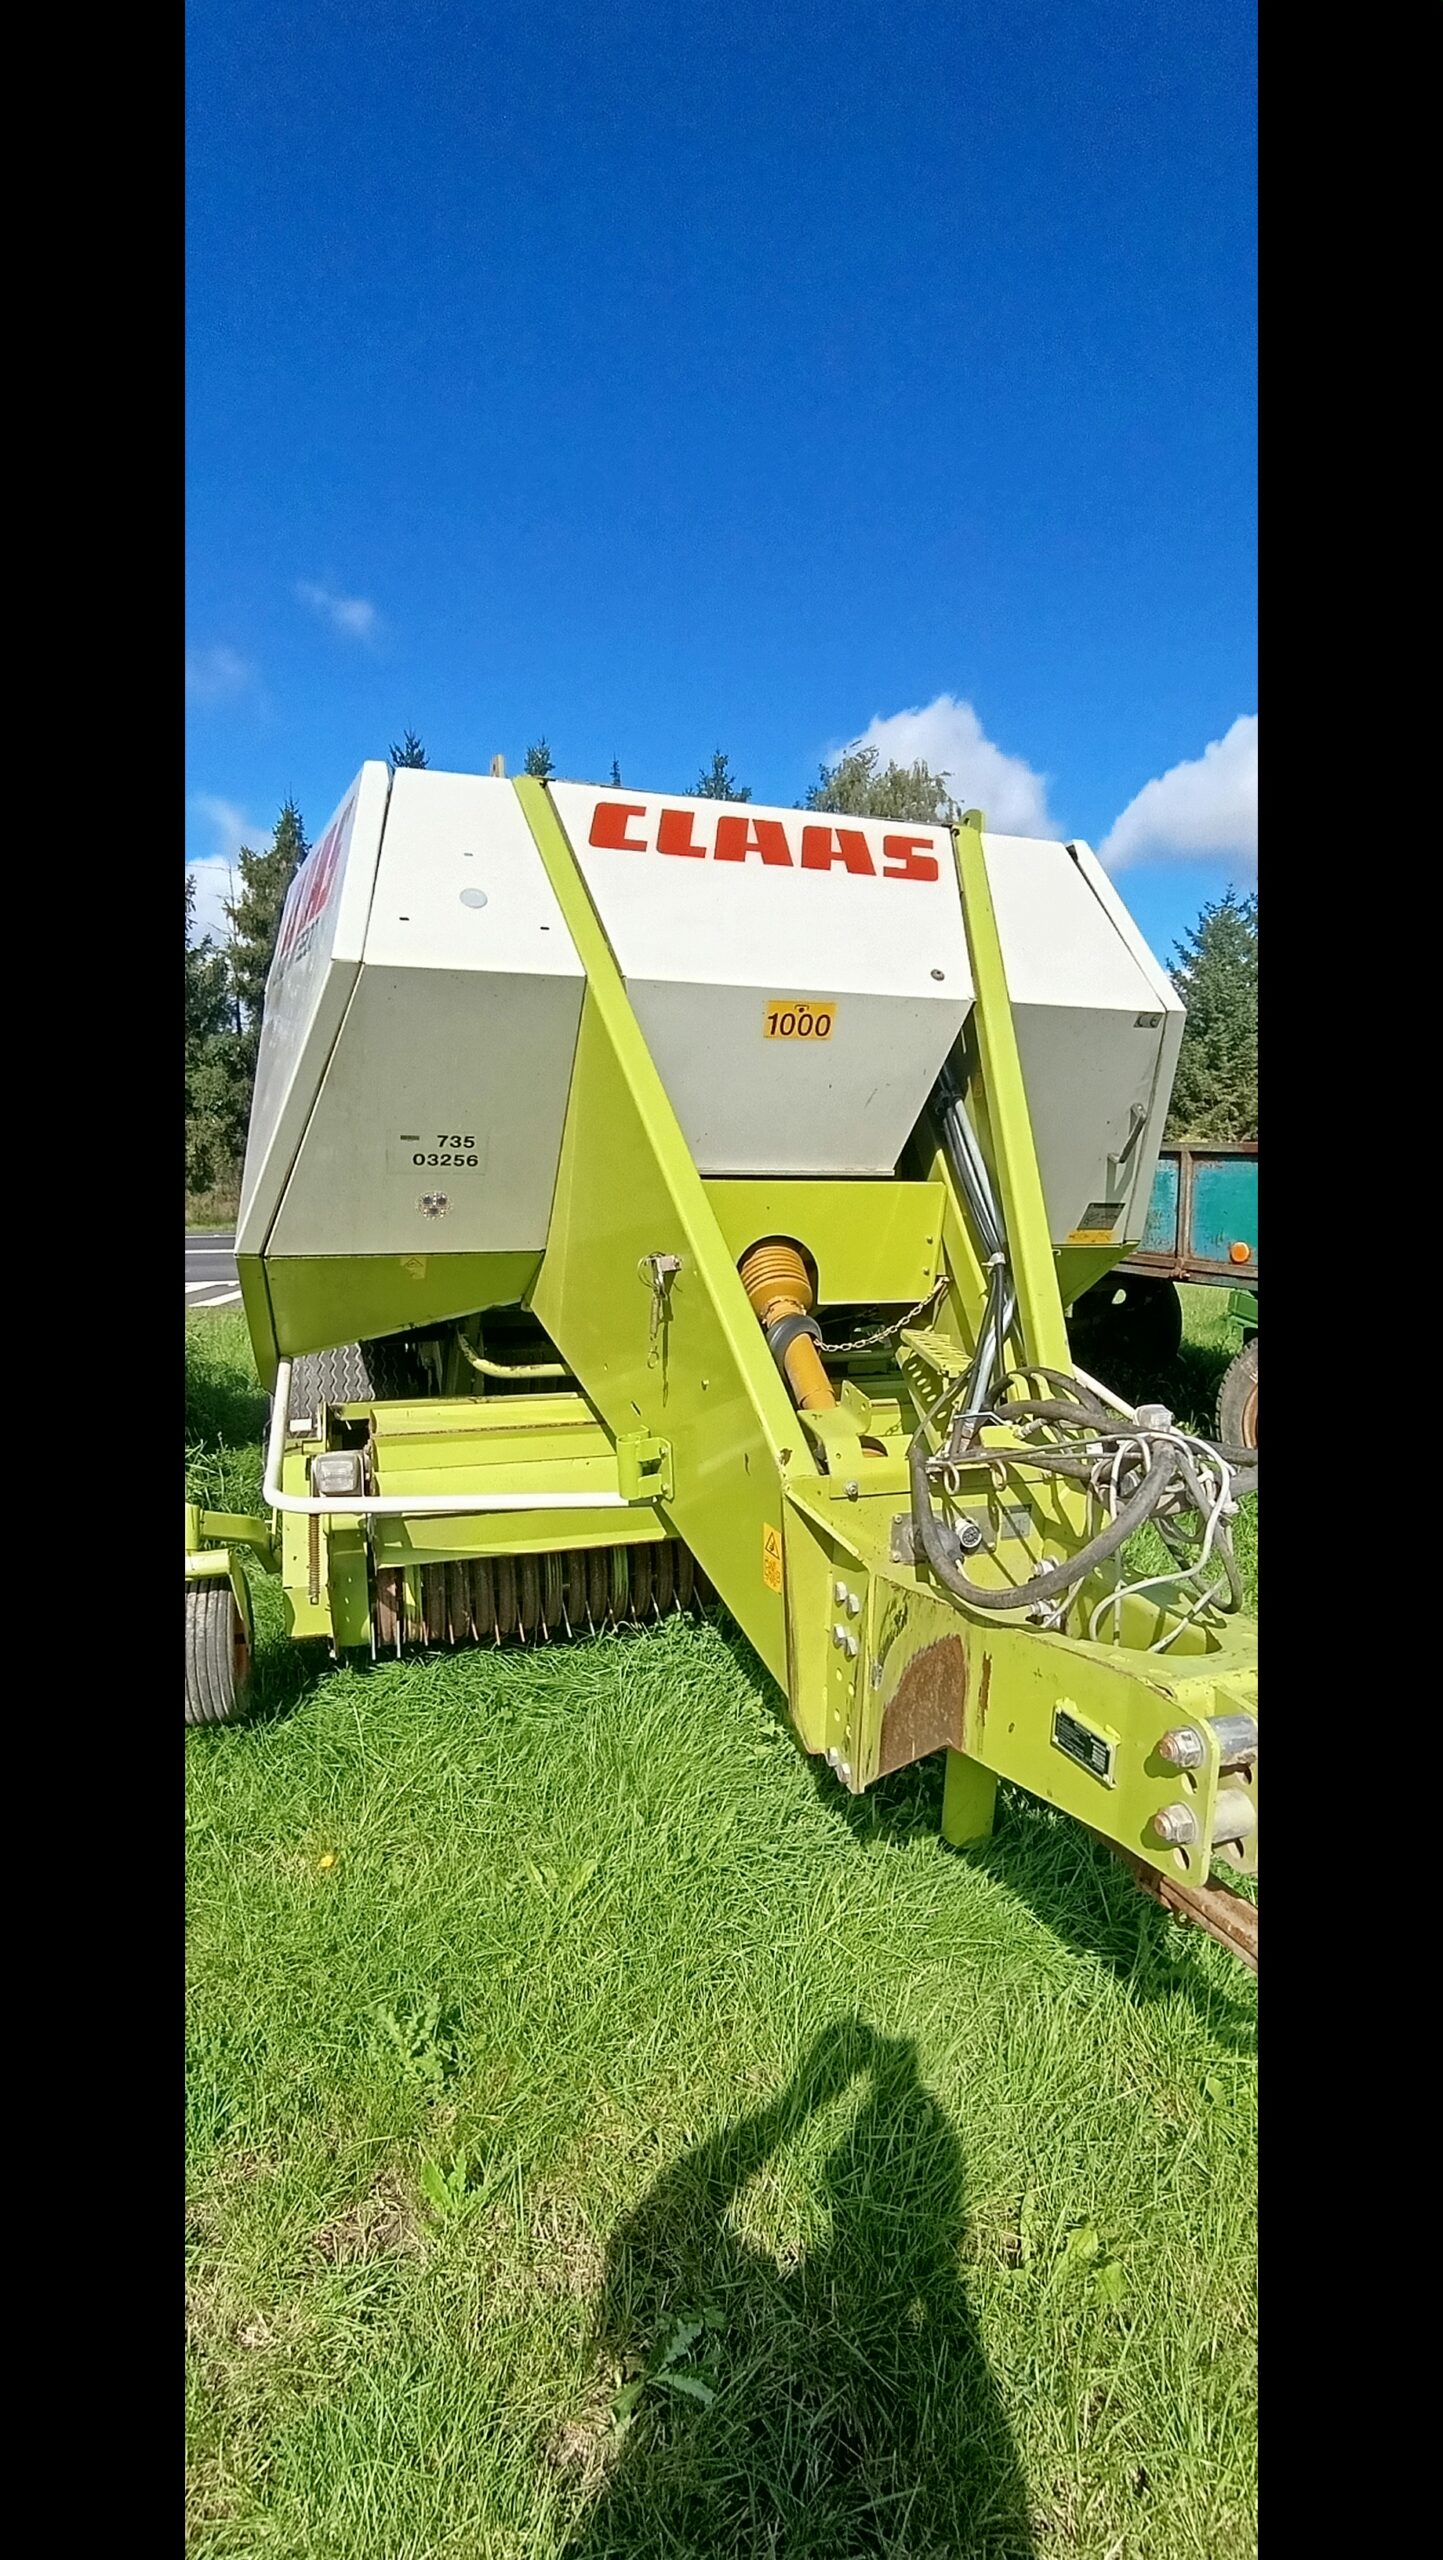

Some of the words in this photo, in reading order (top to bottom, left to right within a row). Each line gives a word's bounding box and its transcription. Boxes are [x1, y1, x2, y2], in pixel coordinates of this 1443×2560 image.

[589, 802, 938, 881] CLAAS
[768, 1012, 831, 1037] 1000
[437, 1135, 475, 1148] 735
[413, 1153, 478, 1167] 03256
